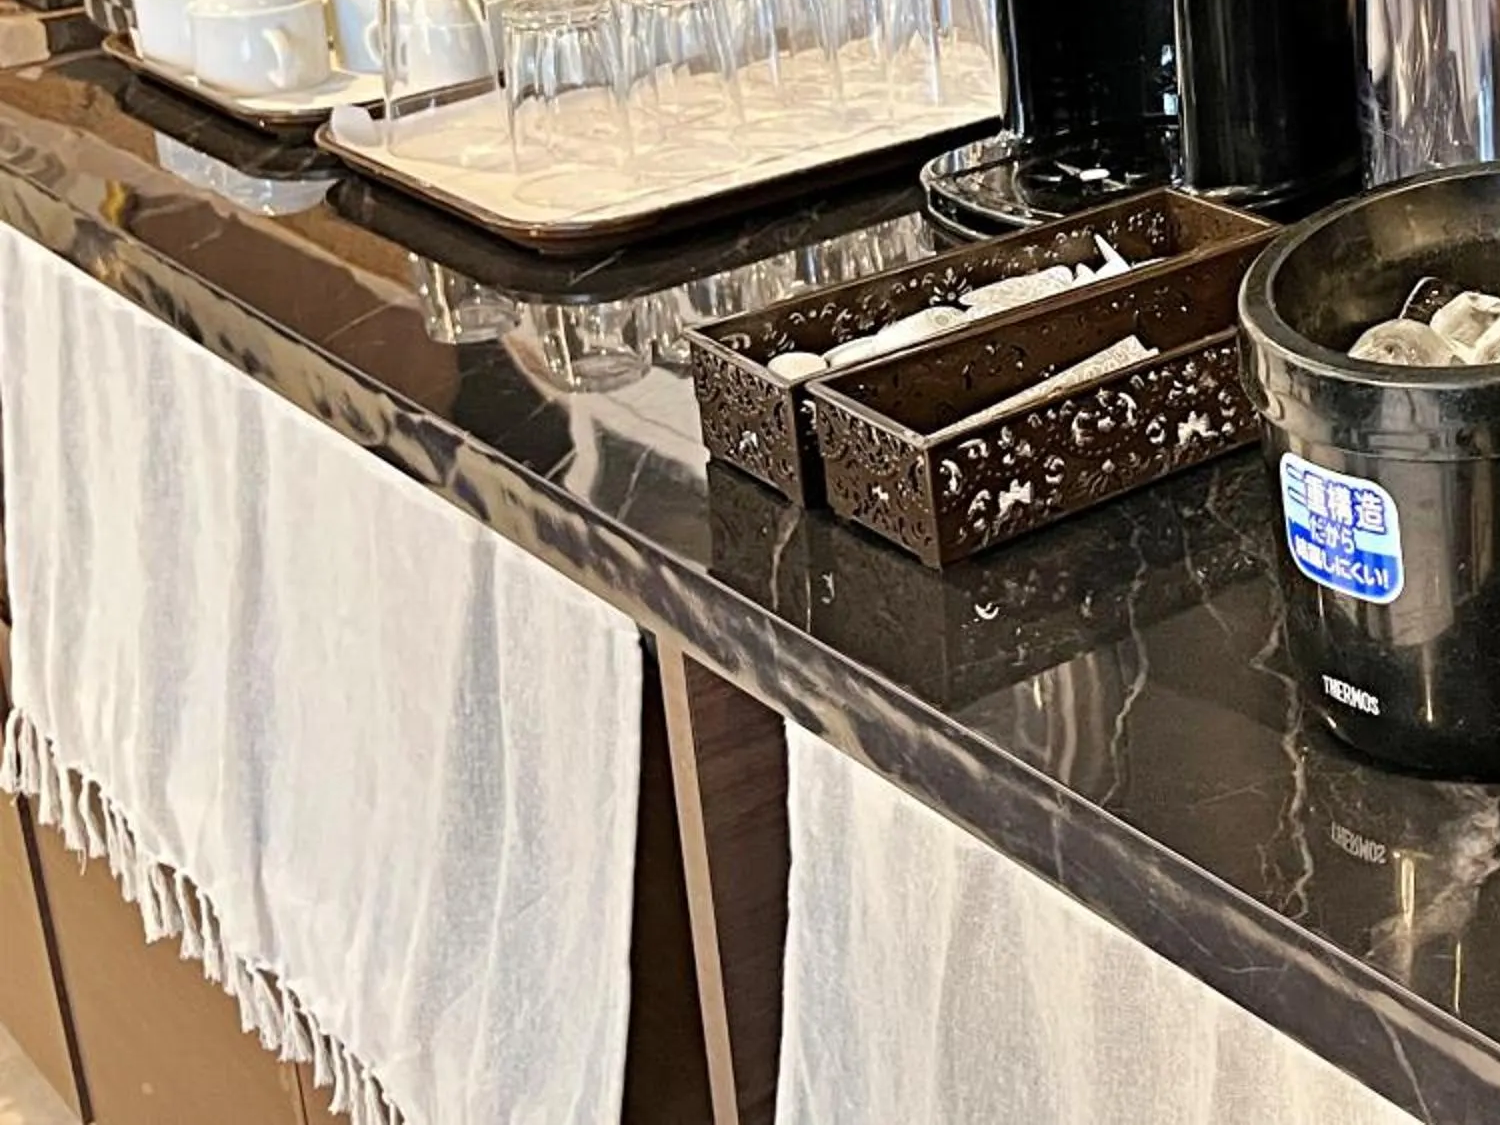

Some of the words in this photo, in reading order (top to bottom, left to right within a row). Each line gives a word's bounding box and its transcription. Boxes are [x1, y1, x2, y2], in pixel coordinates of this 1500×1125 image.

[1310, 514, 1356, 554] だから
[1321, 674, 1380, 716] THERMOS
